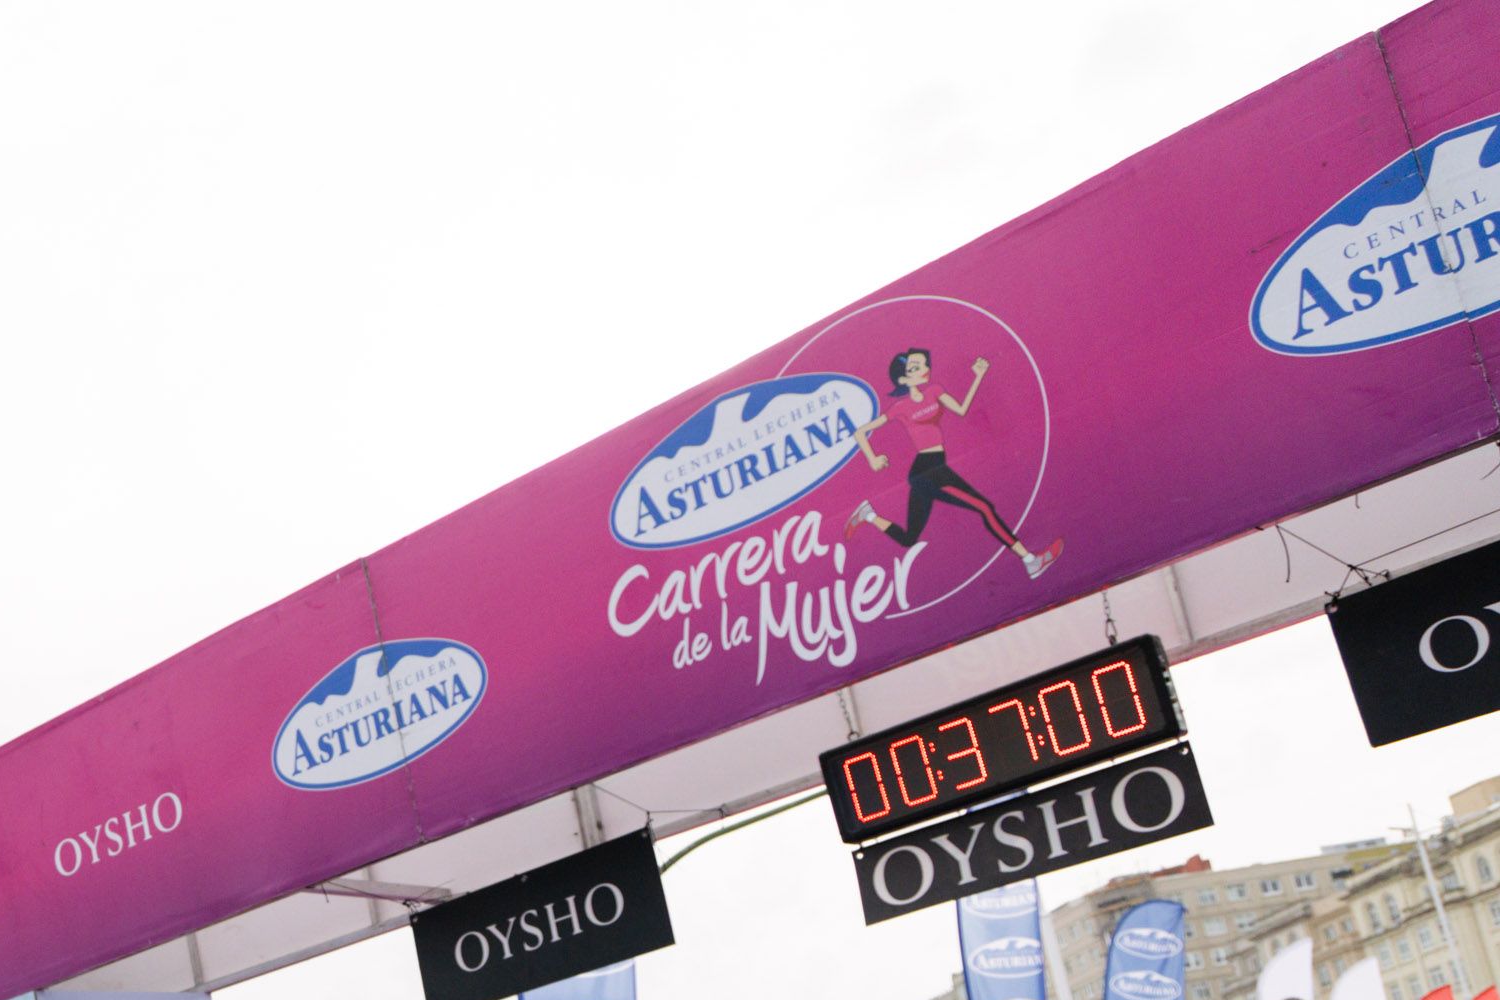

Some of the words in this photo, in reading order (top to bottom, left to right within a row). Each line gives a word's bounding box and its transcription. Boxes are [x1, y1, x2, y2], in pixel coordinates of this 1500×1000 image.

[1342, 188, 1487, 260] CENTRAL
[632, 406, 859, 538] ASTURIANA
[663, 436, 748, 484] CENTRAL
[753, 390, 841, 441] LECHERA
[607, 510, 829, 638] Carrera
[672, 614, 713, 670] de
[720, 599, 752, 653] la
[755, 540, 929, 687] Mujer
[291, 672, 473, 777] ASTURIANA
[314, 690, 381, 729] CENTRAL
[386, 655, 458, 695] LECHERA
[842, 659, 1147, 823] 00:37:00
[53, 791, 184, 877] OYSHO
[872, 764, 1187, 907] OYSHO
[453, 881, 625, 973] OYSHO
